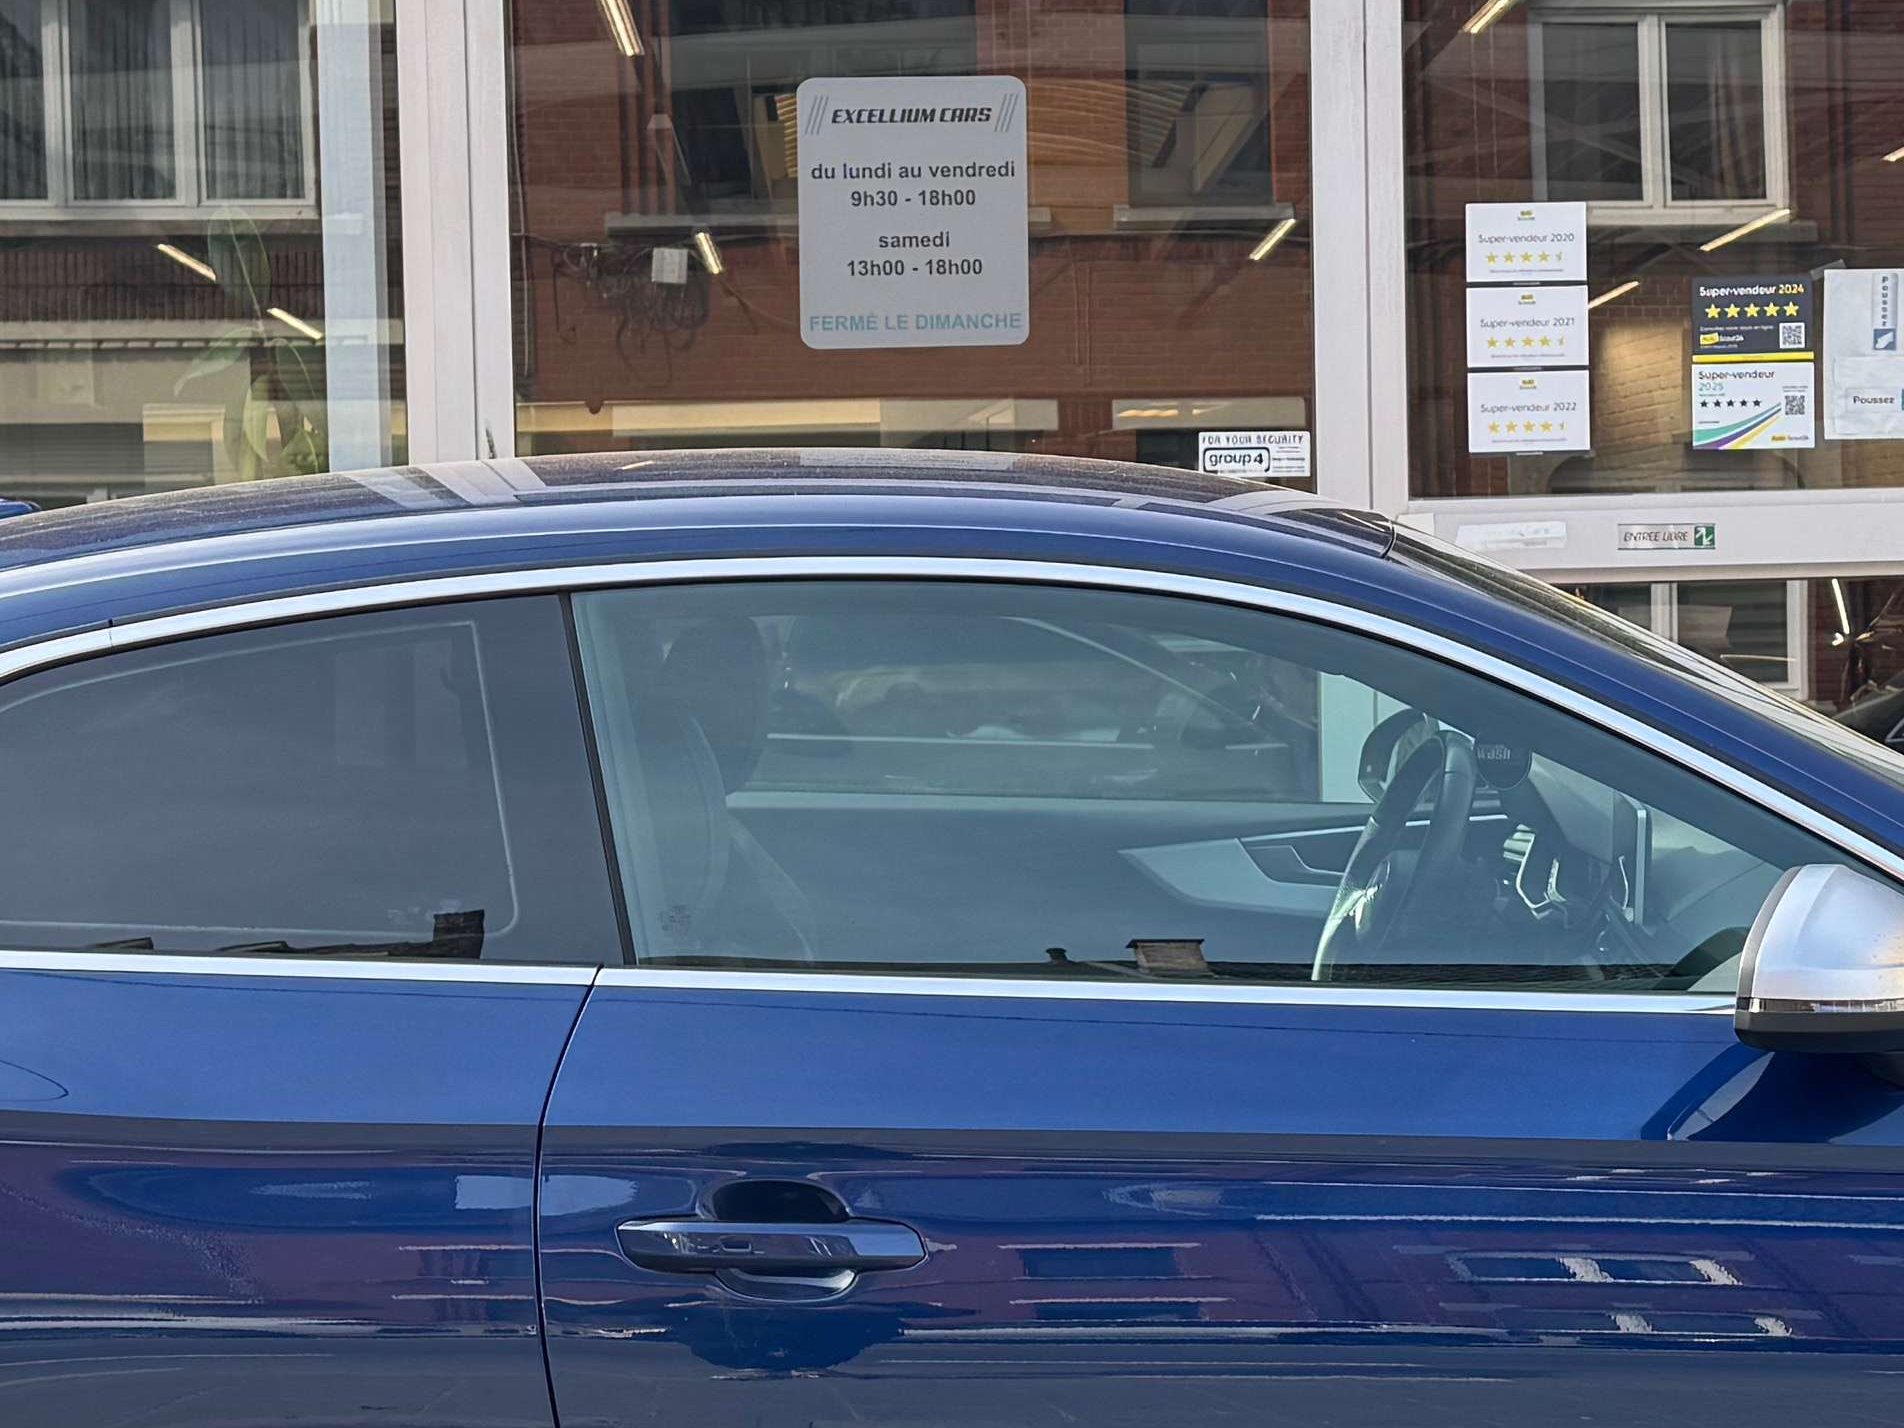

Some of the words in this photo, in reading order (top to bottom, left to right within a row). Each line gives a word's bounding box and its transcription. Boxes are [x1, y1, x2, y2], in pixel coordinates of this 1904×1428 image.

[831, 108, 936, 124] EXCELLIUM
[939, 106, 992, 122] CARS
[811, 164, 836, 180] du
[843, 162, 892, 179] lundi
[898, 166, 922, 179] au
[928, 160, 1016, 178] vendredi
[850, 190, 898, 207] 9h30
[918, 189, 977, 206] 18h00
[878, 231, 951, 248] samedi
[1550, 232, 1575, 243] 2020
[847, 260, 905, 276] 13h00
[925, 259, 983, 275] 18h00
[1699, 285, 1777, 299] Super-vendeur
[1778, 283, 1805, 295] 2024
[884, 315, 909, 331] LE
[916, 312, 1022, 330] DIMANCHE
[1552, 316, 1576, 327] 2021
[1698, 370, 1776, 381] Super-vendeur
[1553, 401, 1577, 412] 2022
[1852, 395, 1896, 405] Poussez
[1202, 435, 1221, 445] FOR
[1226, 435, 1252, 445] YOUR
[1256, 434, 1304, 445] SECURITY
